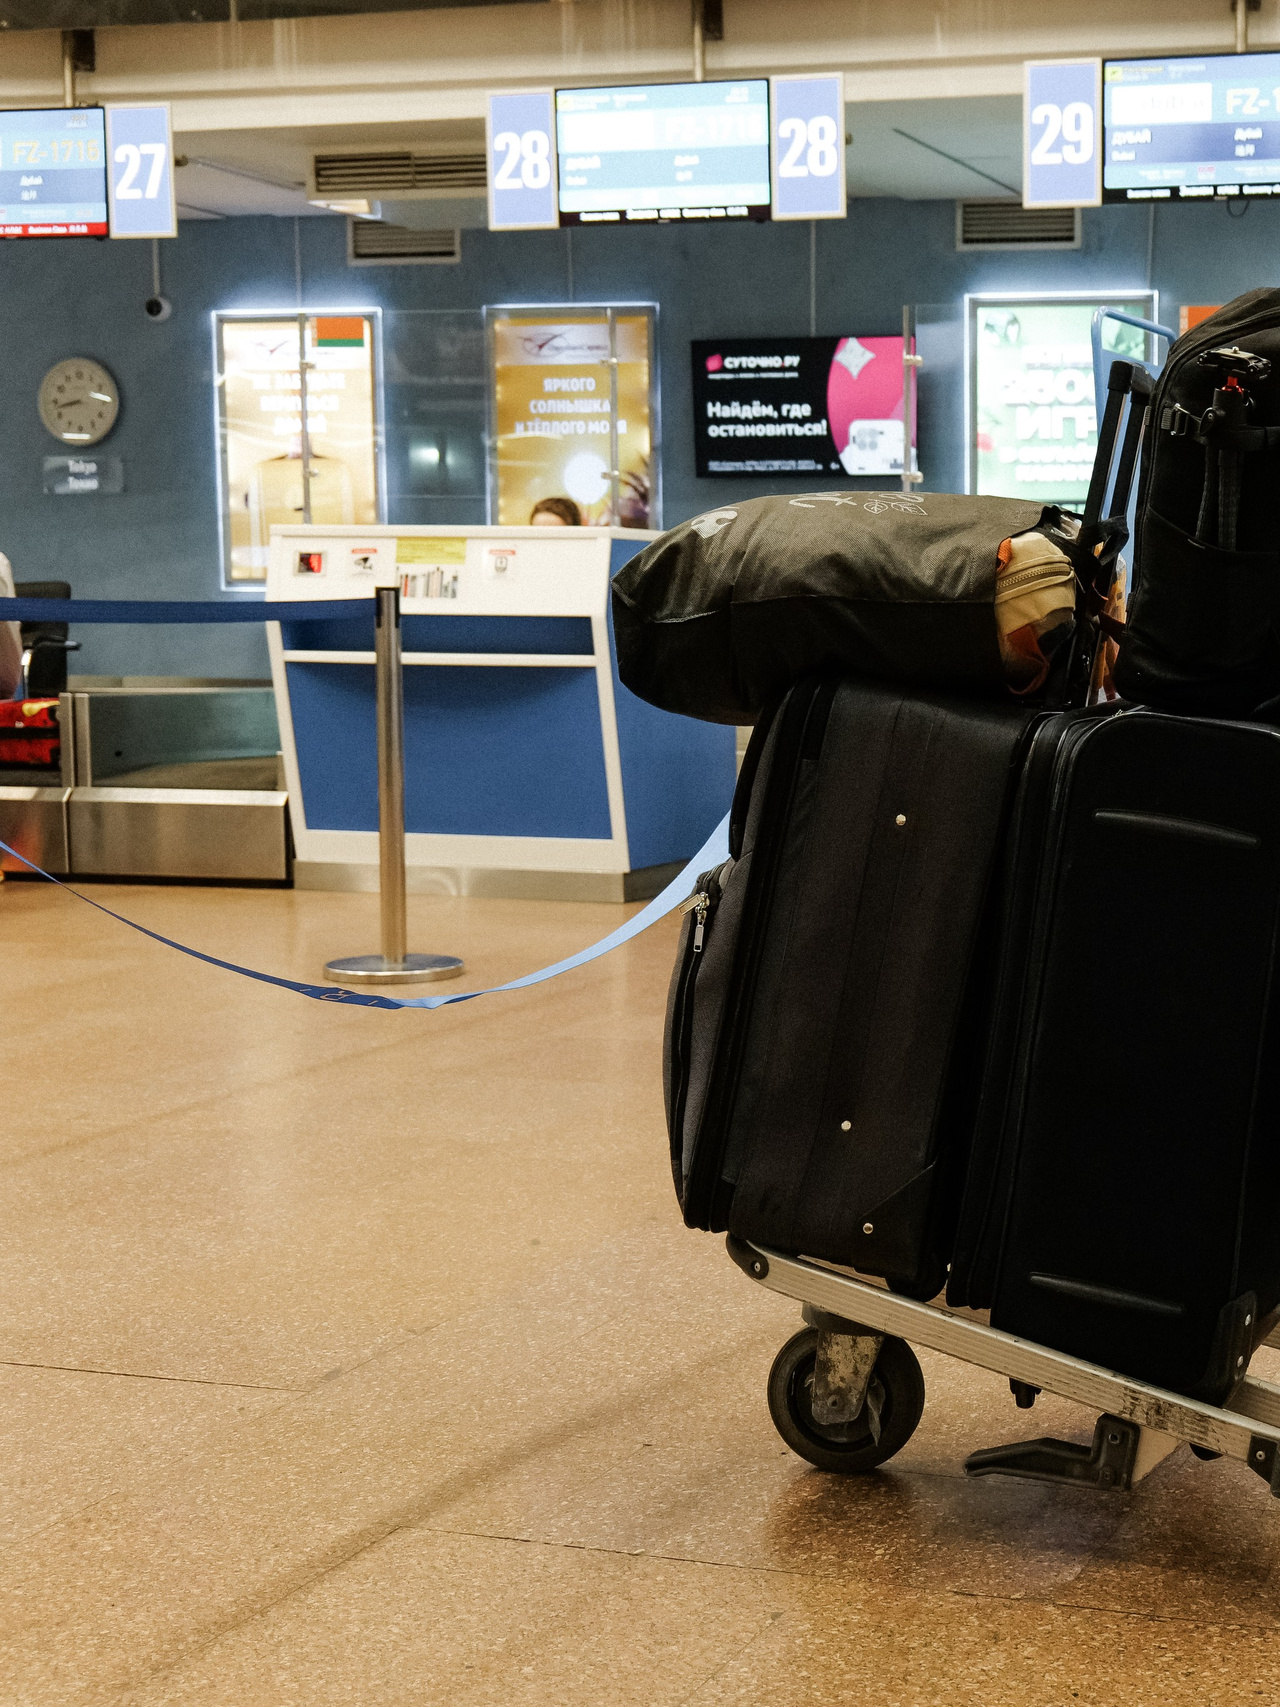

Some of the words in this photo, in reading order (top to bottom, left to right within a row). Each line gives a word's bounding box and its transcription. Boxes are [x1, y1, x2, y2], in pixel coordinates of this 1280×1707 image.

[1030, 101, 1094, 166] 29
[12, 139, 100, 164] FZ-1716
[778, 115, 838, 178] 28
[494, 130, 551, 189] 28
[114, 143, 166, 200] 27
[543, 377, 596, 392] ЯРКОГО
[529, 399, 611, 414] СОЛНЫШКА
[707, 400, 778, 420] Найдём,
[781, 403, 812, 419] где
[588, 420, 627, 435] МОЯ
[708, 419, 827, 438] остановиться!
